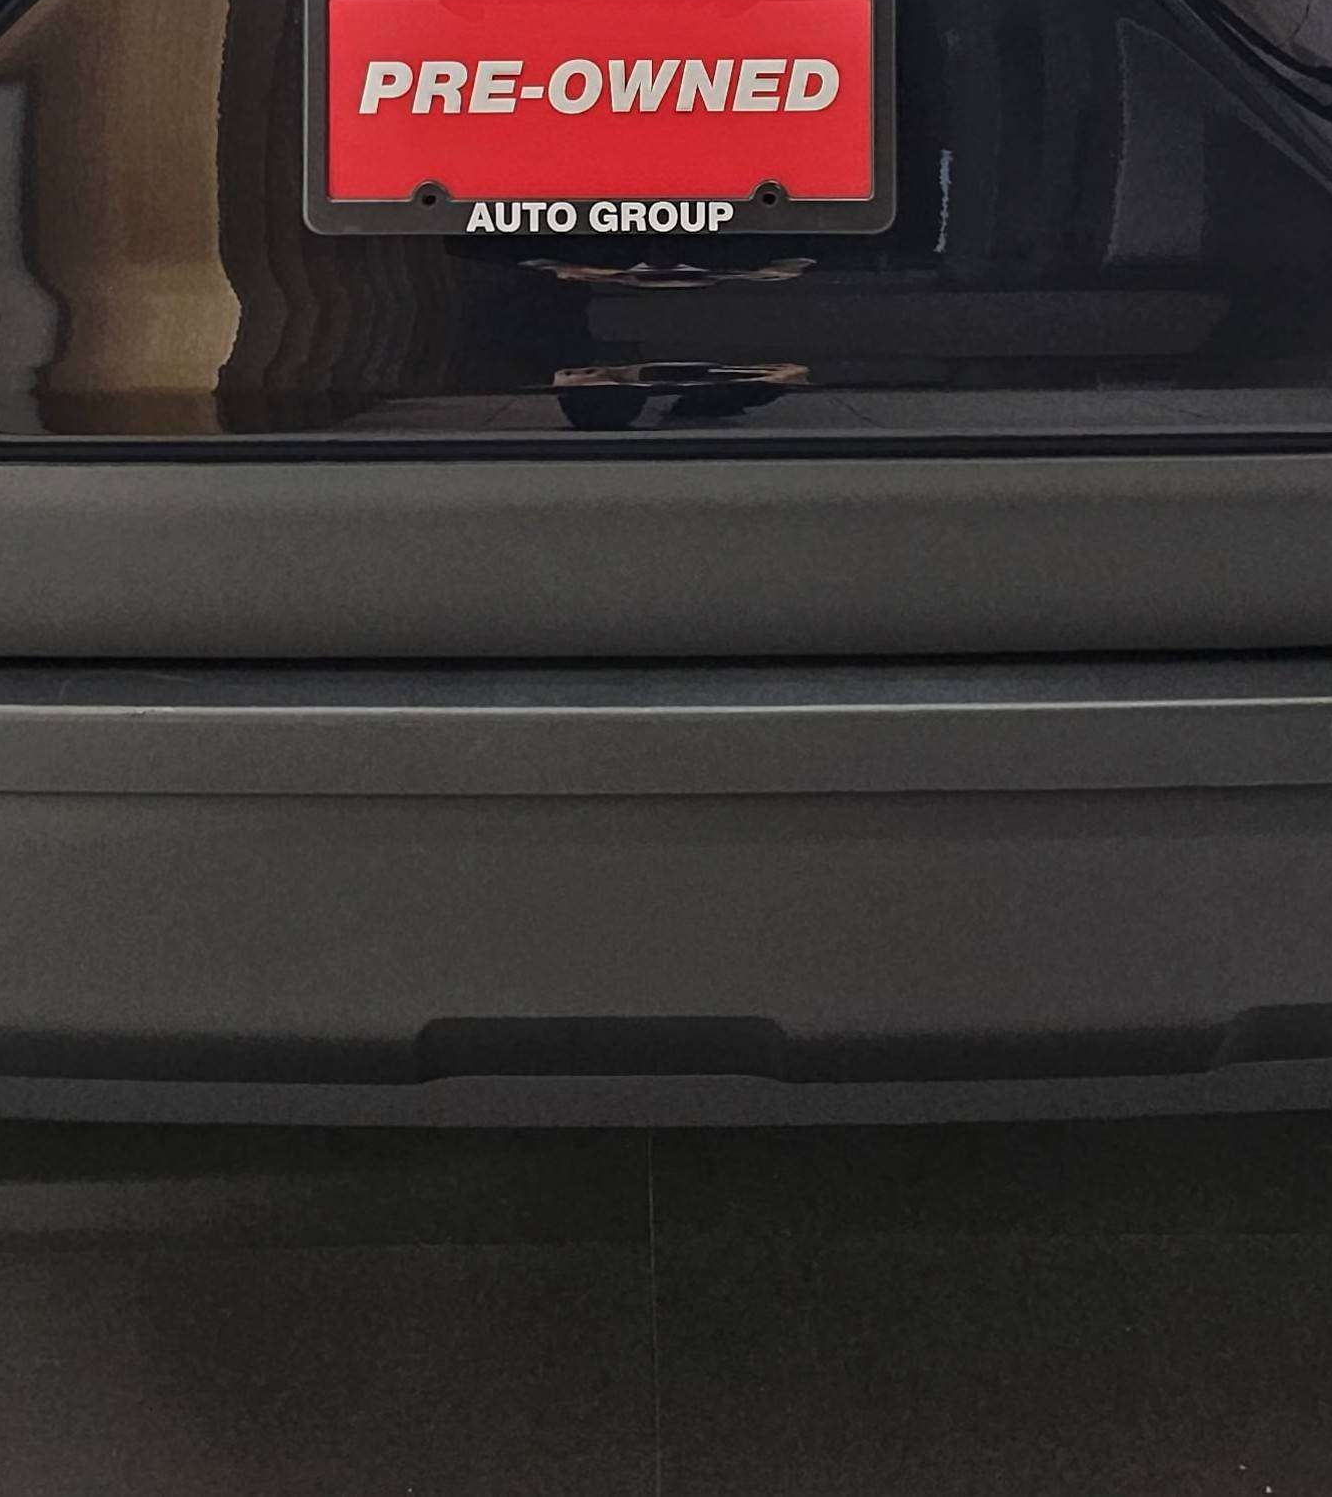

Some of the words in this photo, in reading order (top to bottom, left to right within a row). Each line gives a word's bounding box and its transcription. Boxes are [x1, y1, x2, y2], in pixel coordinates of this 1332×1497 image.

[359, 58, 841, 114] PRE-OWNED
[466, 202, 577, 233] AUTO
[589, 202, 735, 233] GROUP
